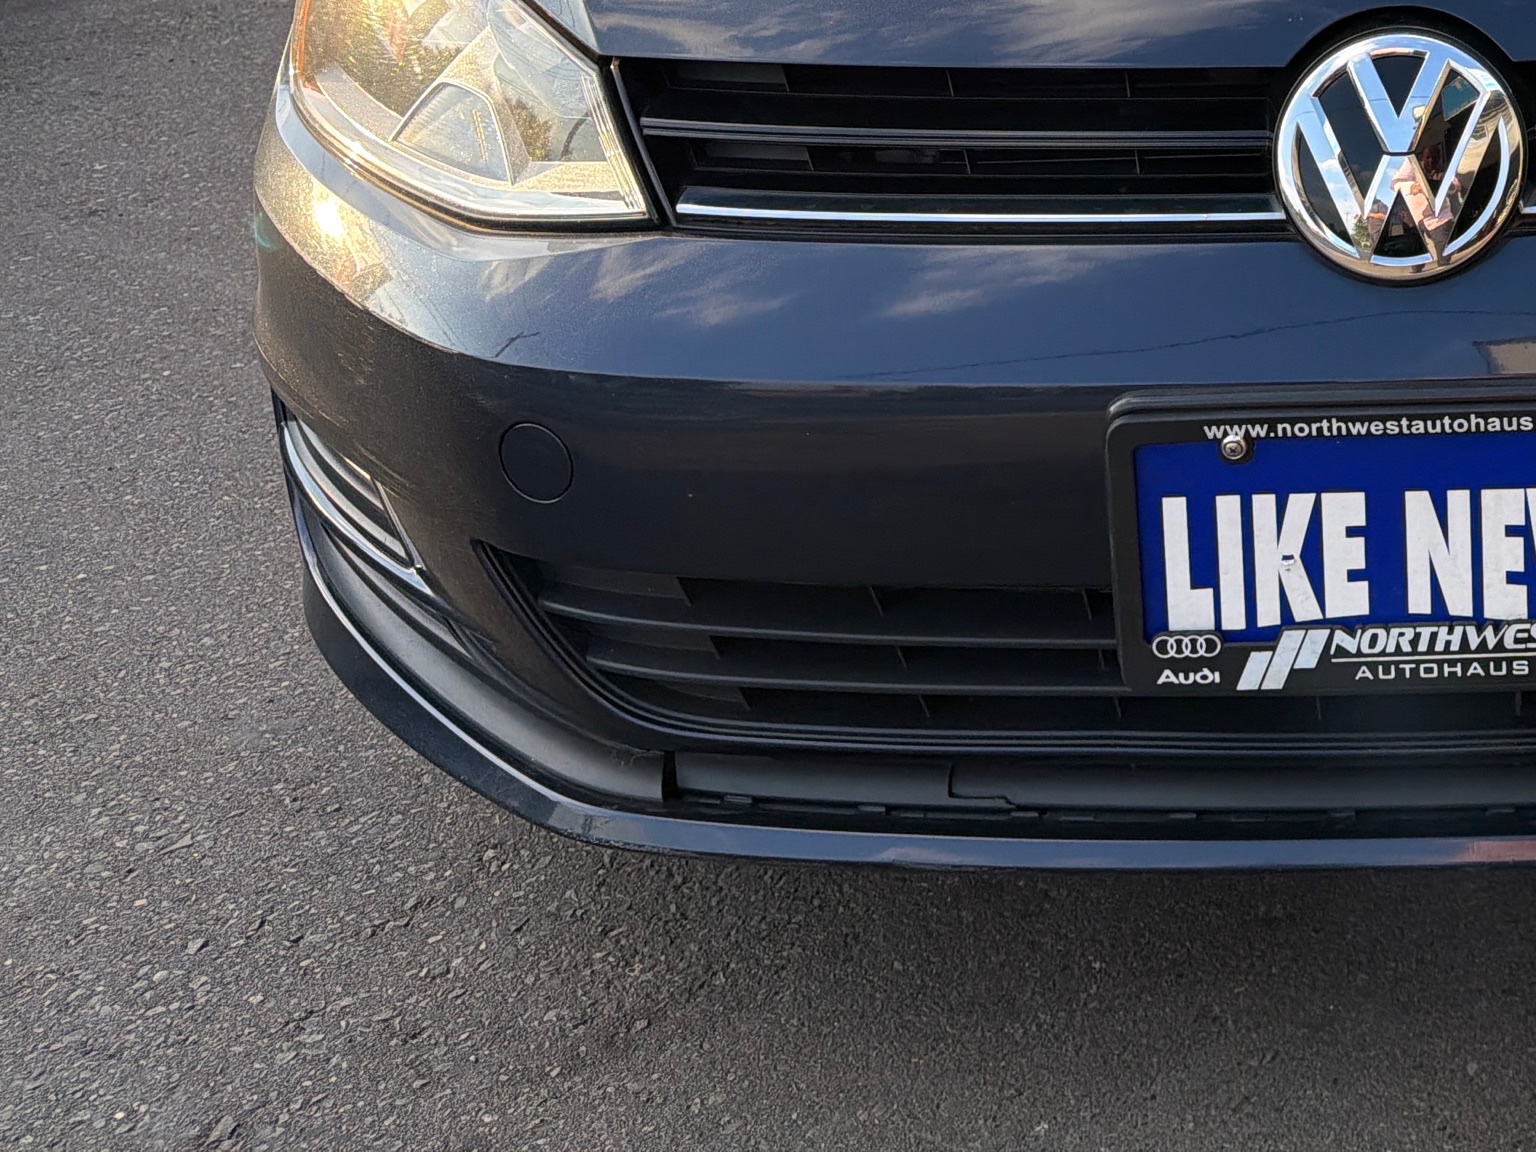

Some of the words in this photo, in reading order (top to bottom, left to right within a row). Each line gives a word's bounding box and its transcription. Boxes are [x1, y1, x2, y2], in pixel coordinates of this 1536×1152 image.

[1162, 491, 1370, 632] LIKE
[1156, 668, 1221, 685] Audi
[1355, 660, 1530, 680] AUTOHAUS
